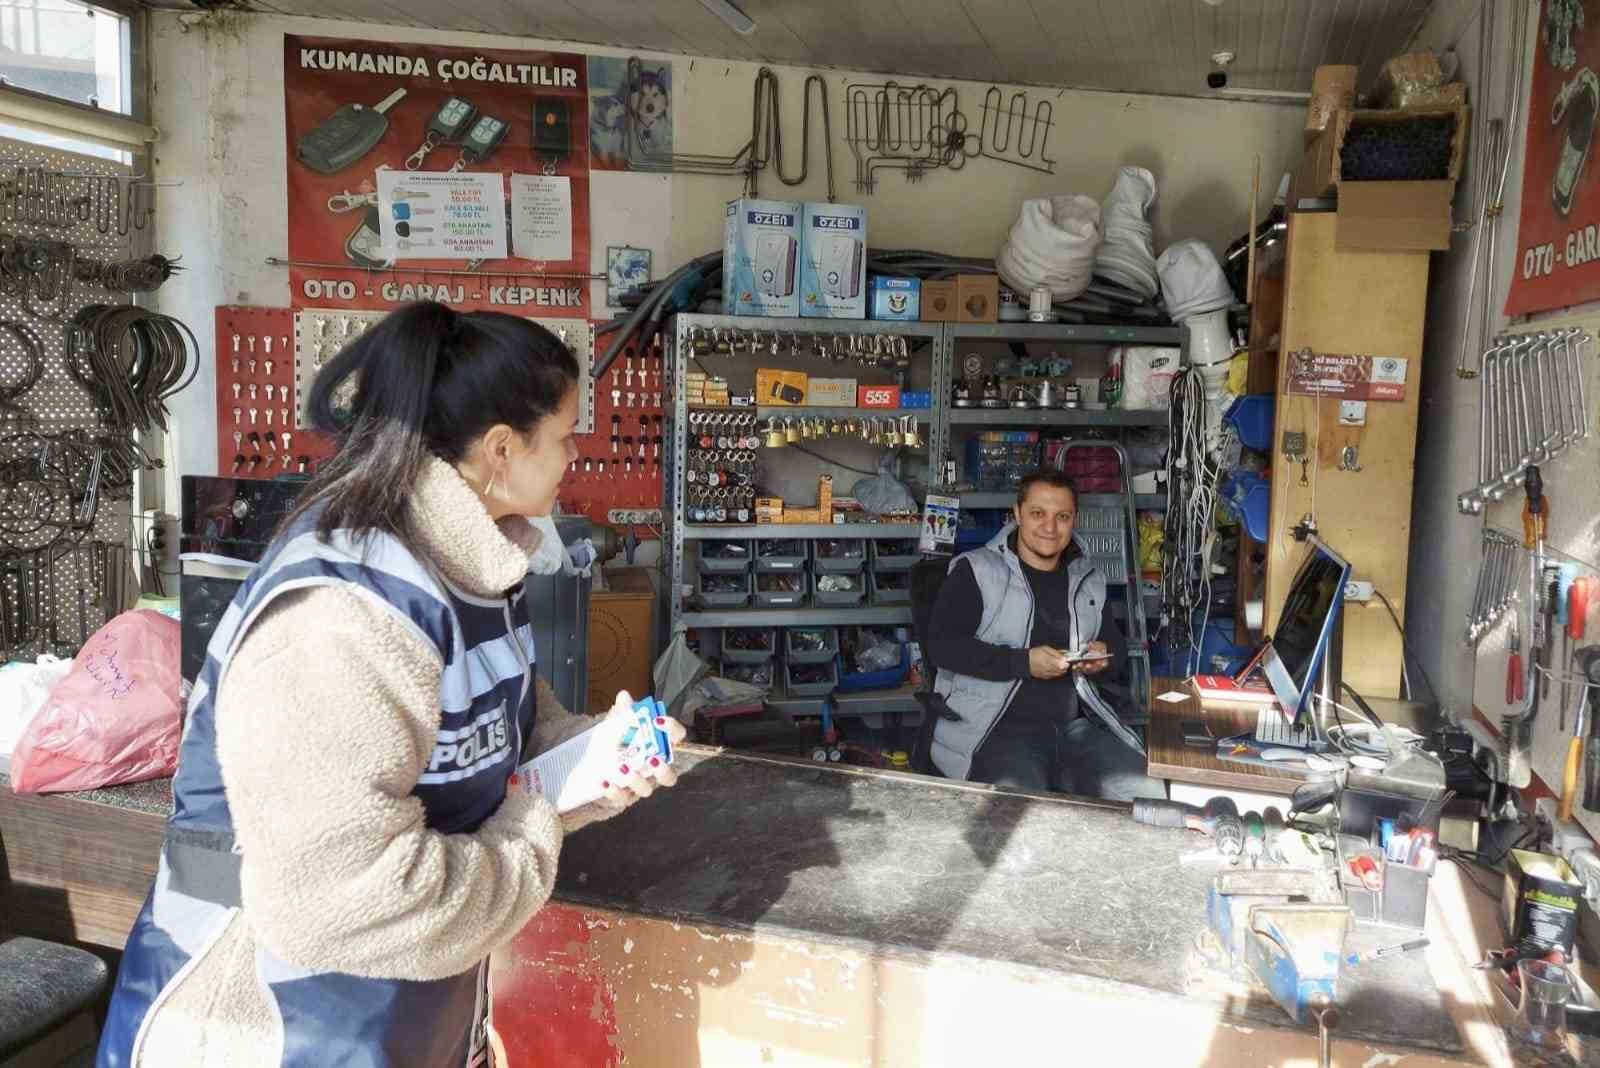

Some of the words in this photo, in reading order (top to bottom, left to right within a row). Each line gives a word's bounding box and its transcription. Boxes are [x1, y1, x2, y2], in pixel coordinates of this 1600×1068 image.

[301, 48, 430, 77] KUMANDA
[437, 57, 577, 88] ÇOĞALTILIR
[1523, 242, 1554, 280] OTO
[1566, 224, 1600, 268] GAR
[303, 279, 356, 299] OTO
[490, 286, 583, 307] KEPENK
